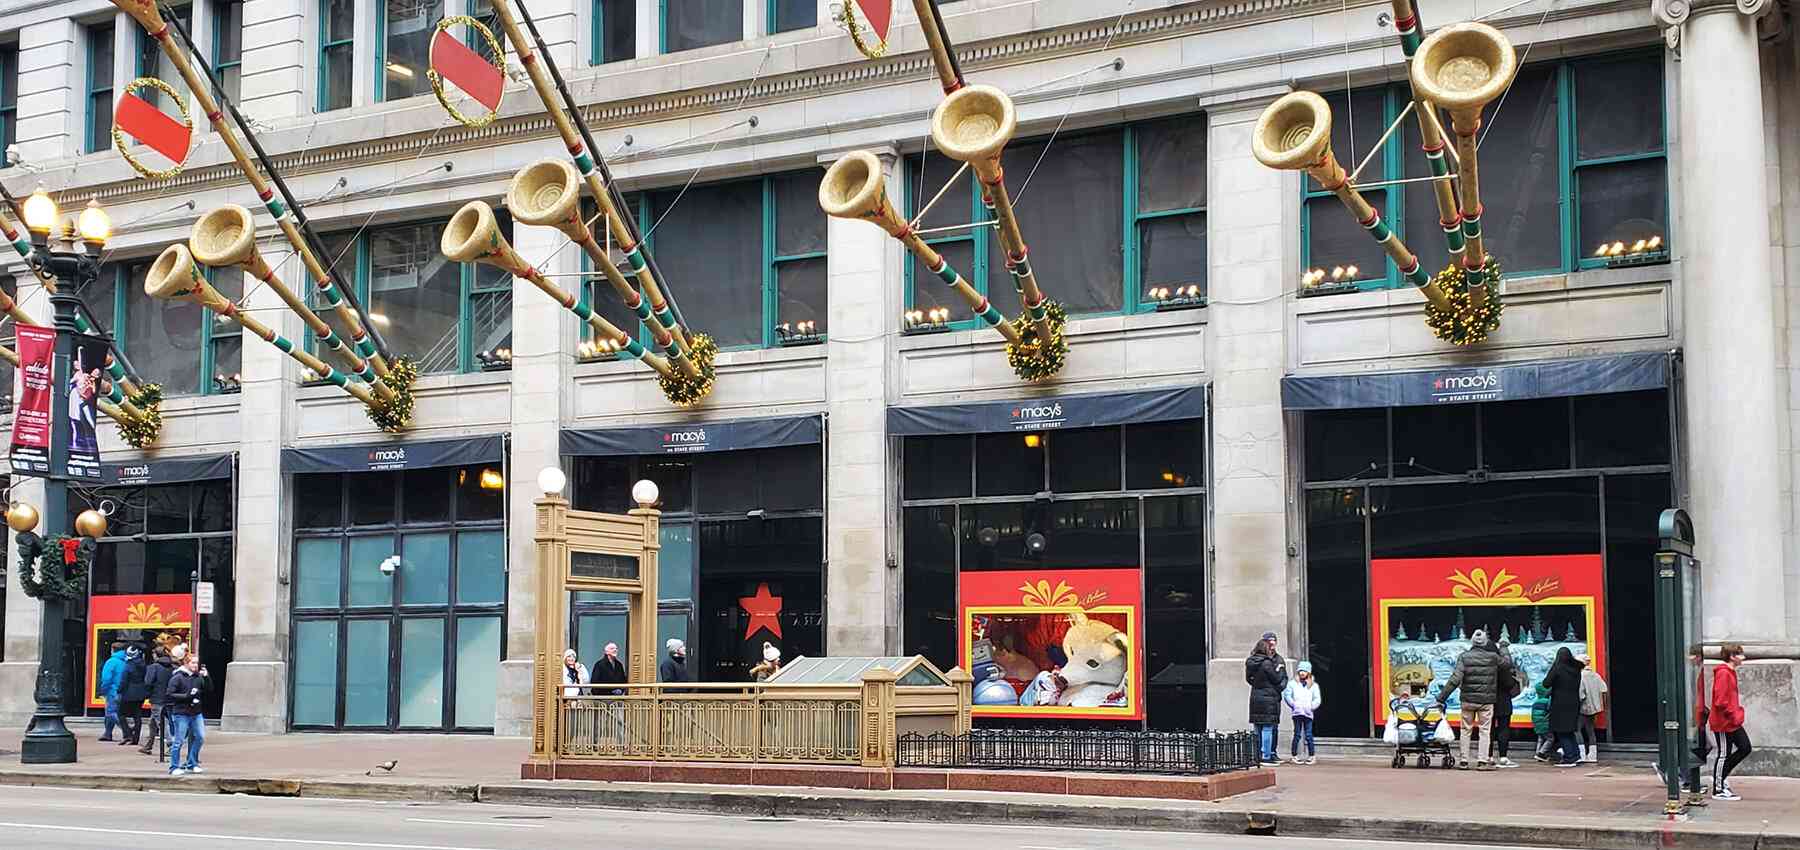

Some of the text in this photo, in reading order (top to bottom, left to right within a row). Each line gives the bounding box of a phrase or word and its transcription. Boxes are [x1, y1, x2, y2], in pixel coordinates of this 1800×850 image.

[1445, 371, 1496, 389] macy's
[1021, 402, 1062, 418] macy's
[671, 428, 706, 442] macy's
[375, 447, 405, 461] macy's
[123, 464, 149, 477] macy's
